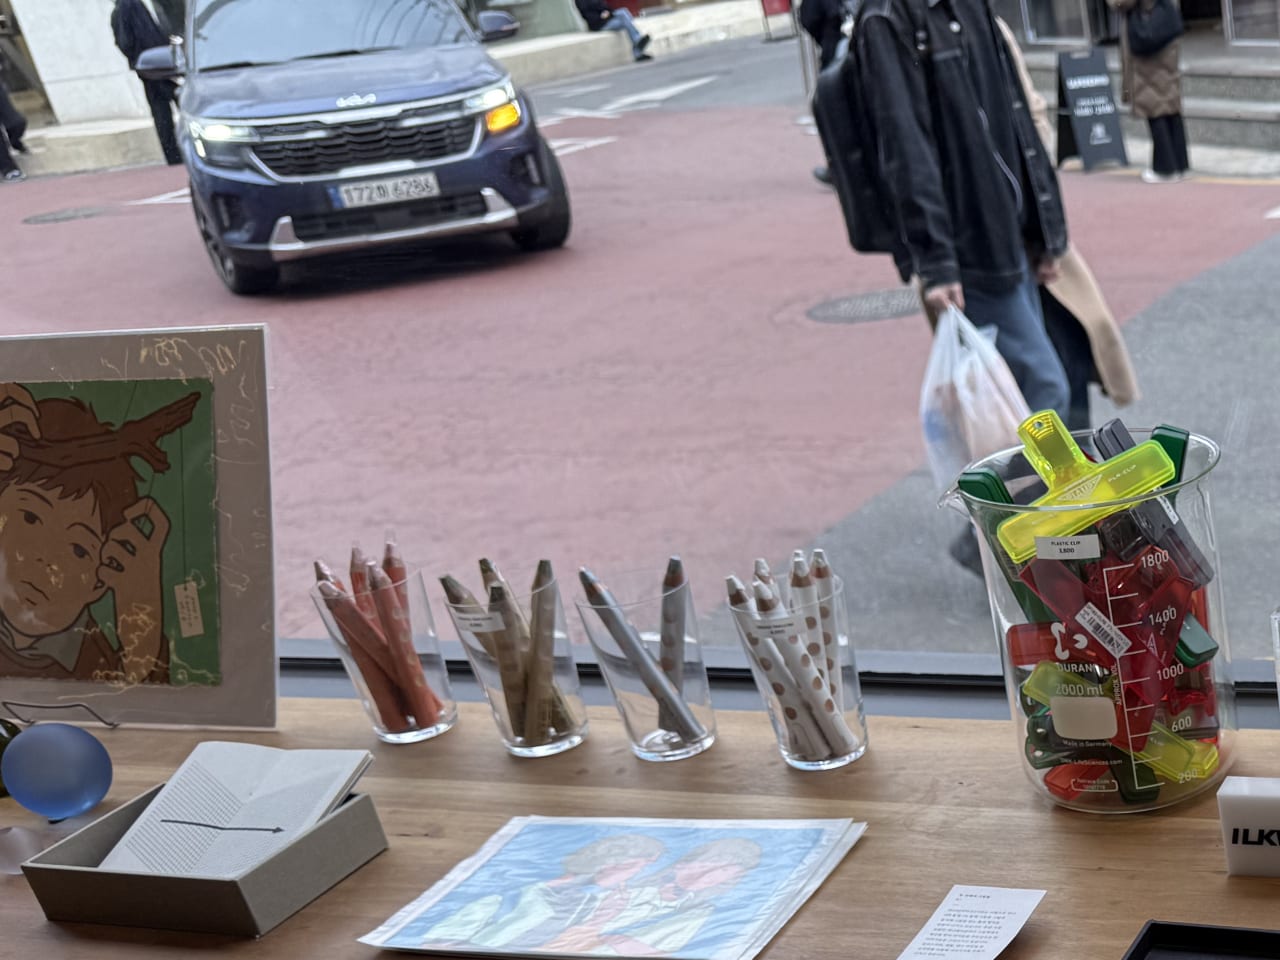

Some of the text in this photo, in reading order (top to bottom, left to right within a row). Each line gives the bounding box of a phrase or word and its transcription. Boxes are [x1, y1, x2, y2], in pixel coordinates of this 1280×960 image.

[1140, 550, 1168, 568] 1800
[1148, 607, 1176, 626] 1400
[1156, 663, 1184, 681] 1000
[1056, 683, 1104, 696] 2000 ml
[1171, 716, 1192, 732] 600
[1178, 768, 1198, 784] 200
